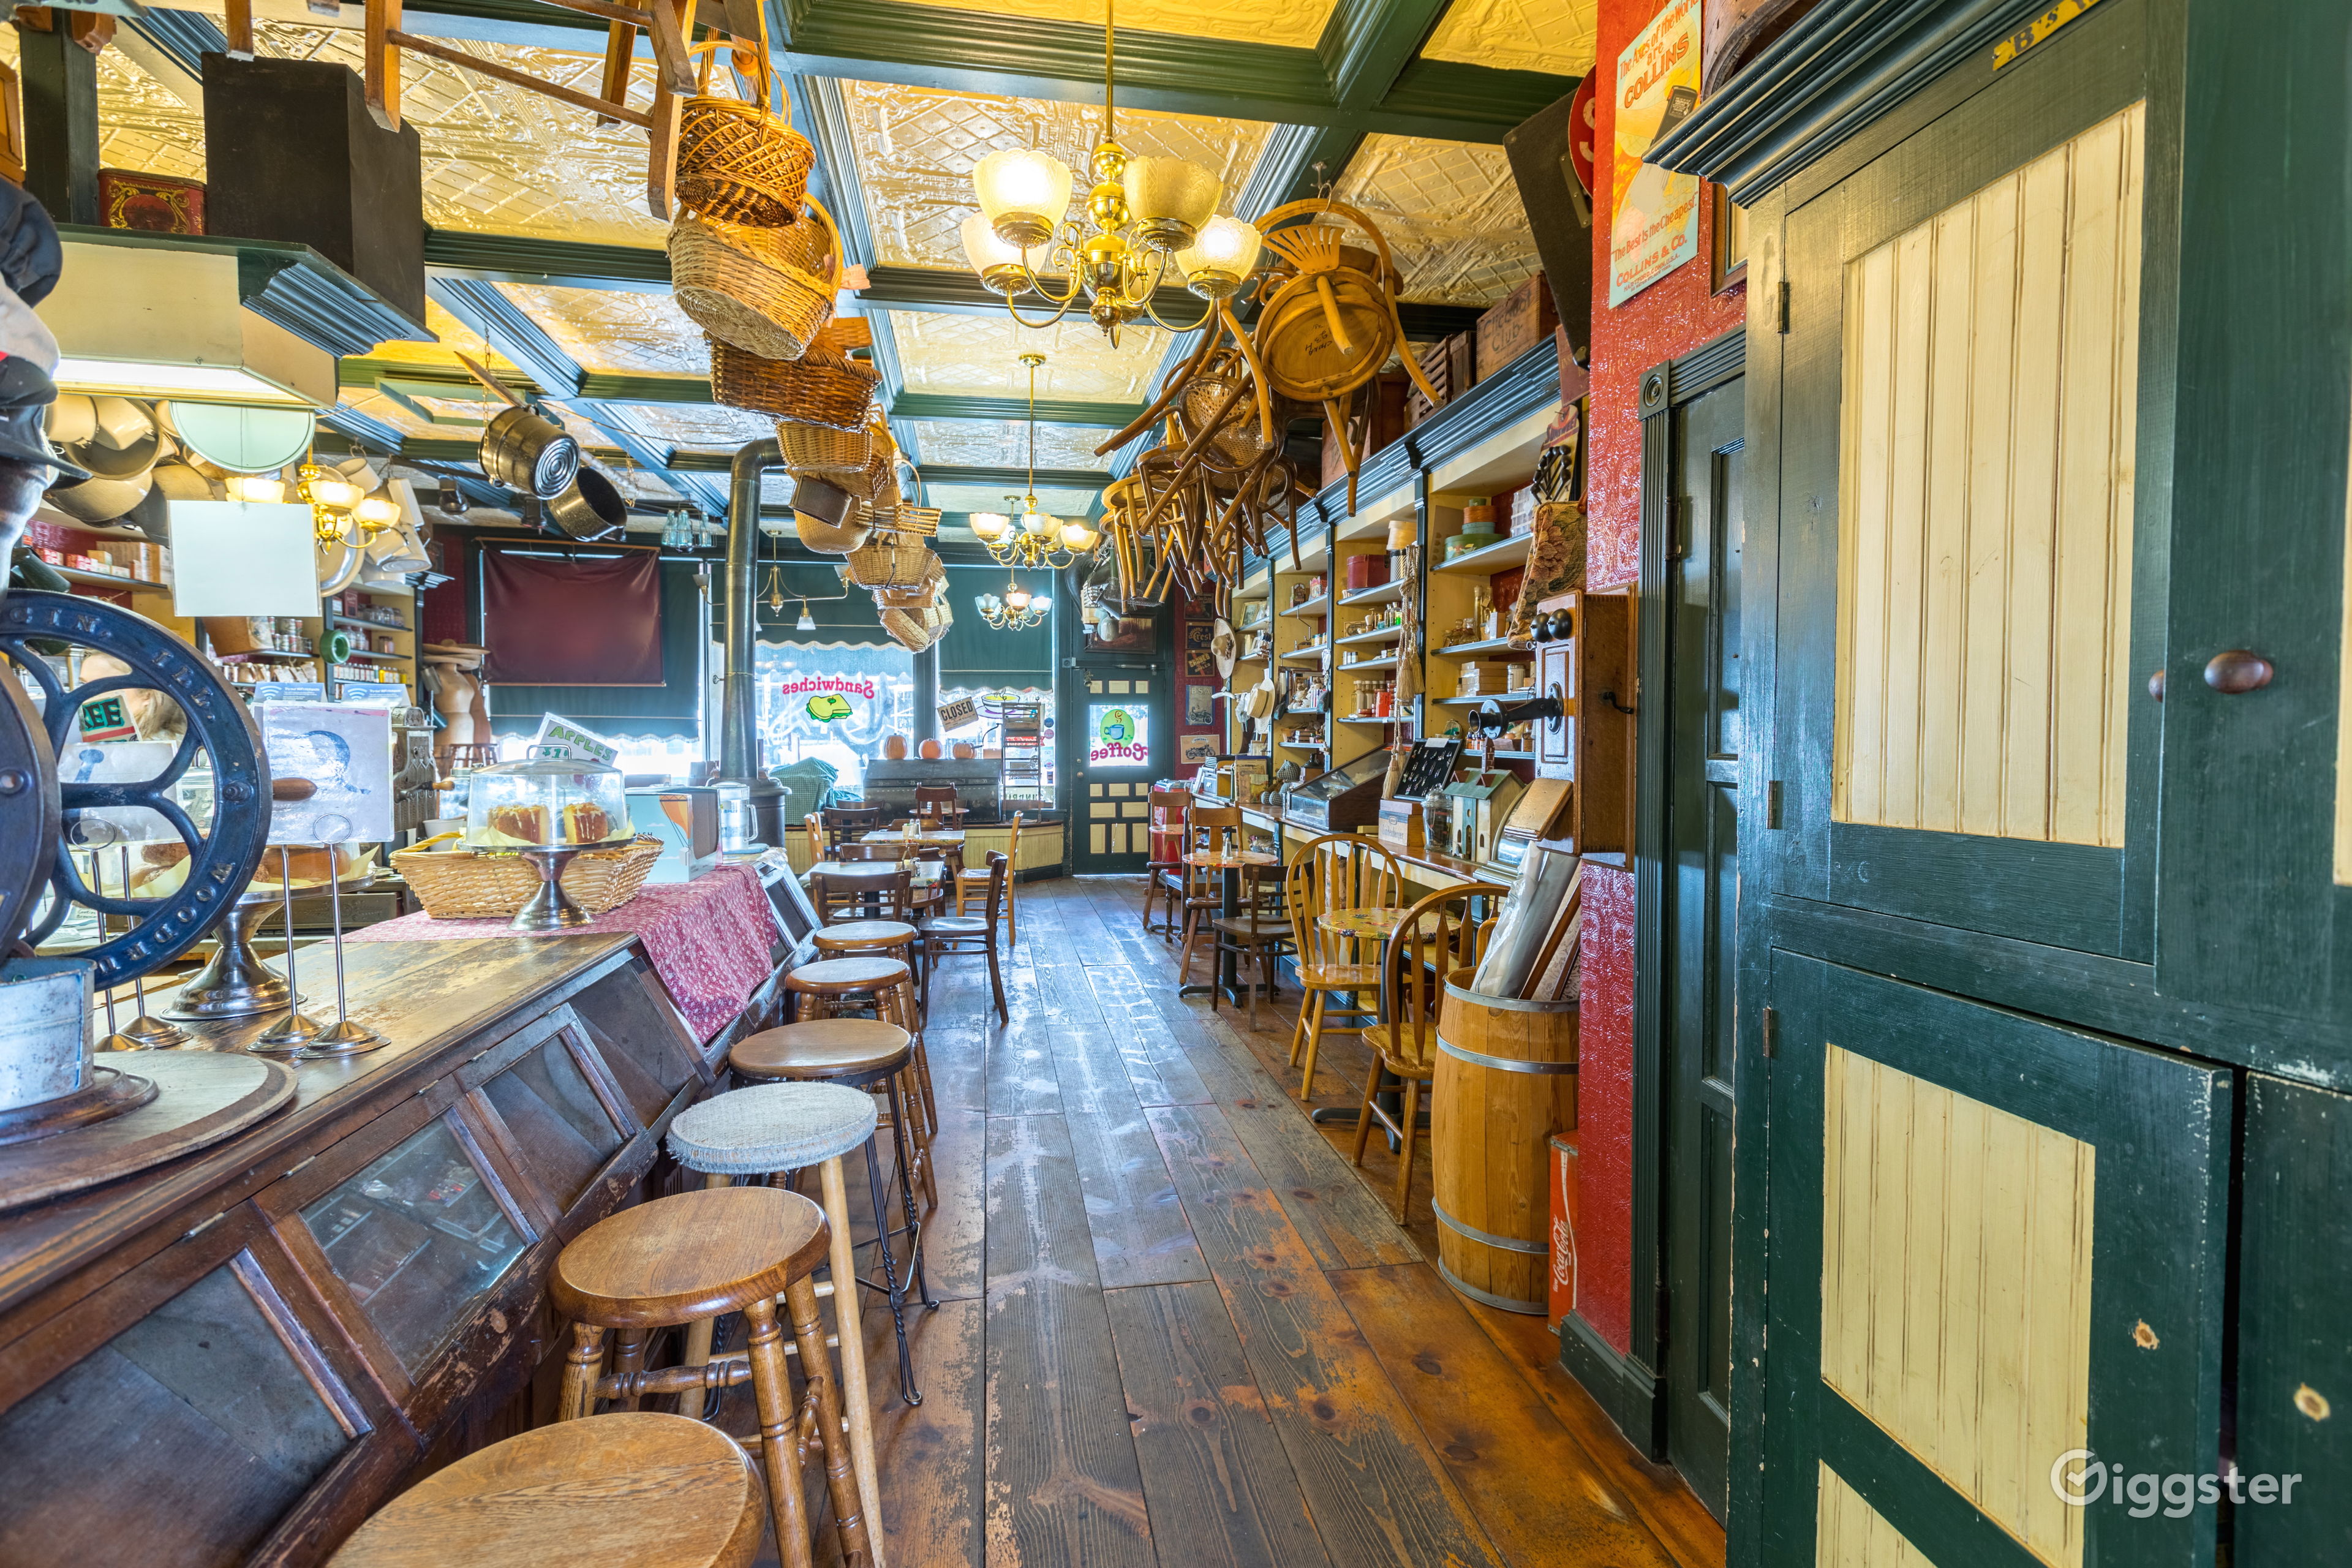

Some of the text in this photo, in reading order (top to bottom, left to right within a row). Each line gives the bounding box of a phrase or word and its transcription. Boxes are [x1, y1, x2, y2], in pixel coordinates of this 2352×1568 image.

[1620, 58, 1632, 79] The
[1632, 39, 1650, 67] Axes
[1651, 24, 1660, 46] of
[1662, 13, 1675, 37] the
[1647, 42, 1664, 66] are
[1624, 32, 1689, 108] COLLINS
[1626, 233, 1642, 254] Best
[1649, 222, 1660, 238] the
[1616, 234, 1687, 287] COLLINS & CO.
[940, 700, 973, 721] CLOSED
[548, 726, 612, 761] APPLES
